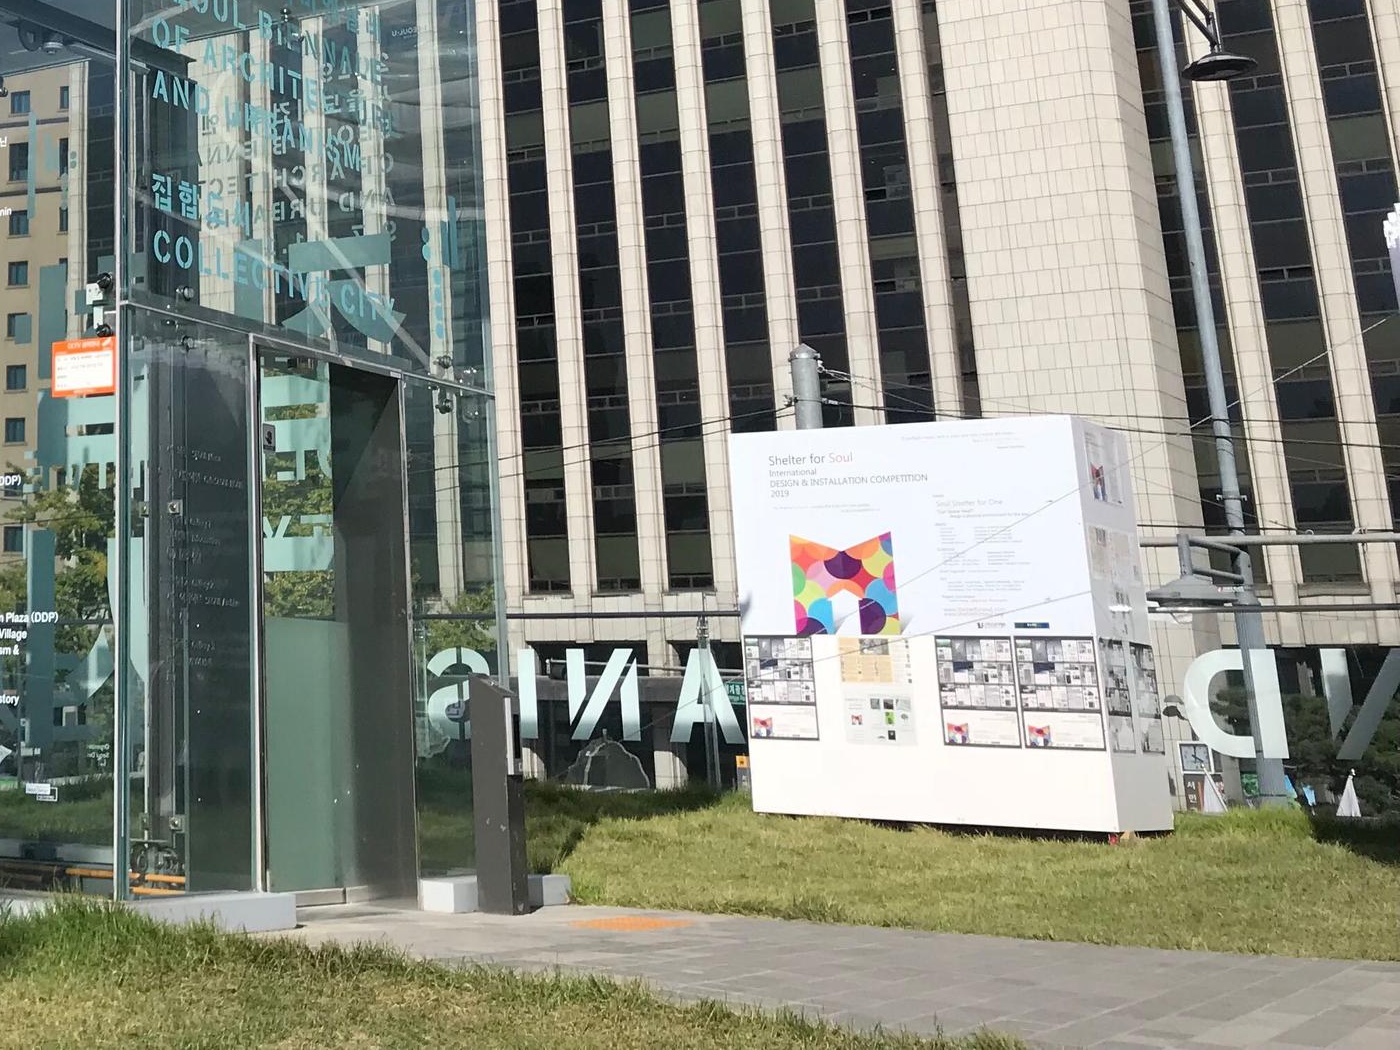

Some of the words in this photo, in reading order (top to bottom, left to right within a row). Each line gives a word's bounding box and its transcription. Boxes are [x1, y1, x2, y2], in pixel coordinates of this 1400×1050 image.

[152, 71, 209, 116] AND
[768, 455, 806, 466] Shelter
[810, 453, 825, 464] for
[828, 452, 853, 463] Soul
[769, 469, 817, 477] International
[770, 479, 800, 488] DESIGN
[801, 479, 808, 487] &
[810, 476, 868, 487] INSTALLATION
[870, 473, 928, 484] COMPETITION
[770, 490, 790, 498] 2019
[5, 612, 30, 623] Plaza
[30, 611, 59, 625] (DDP)
[12, 644, 20, 655] &
